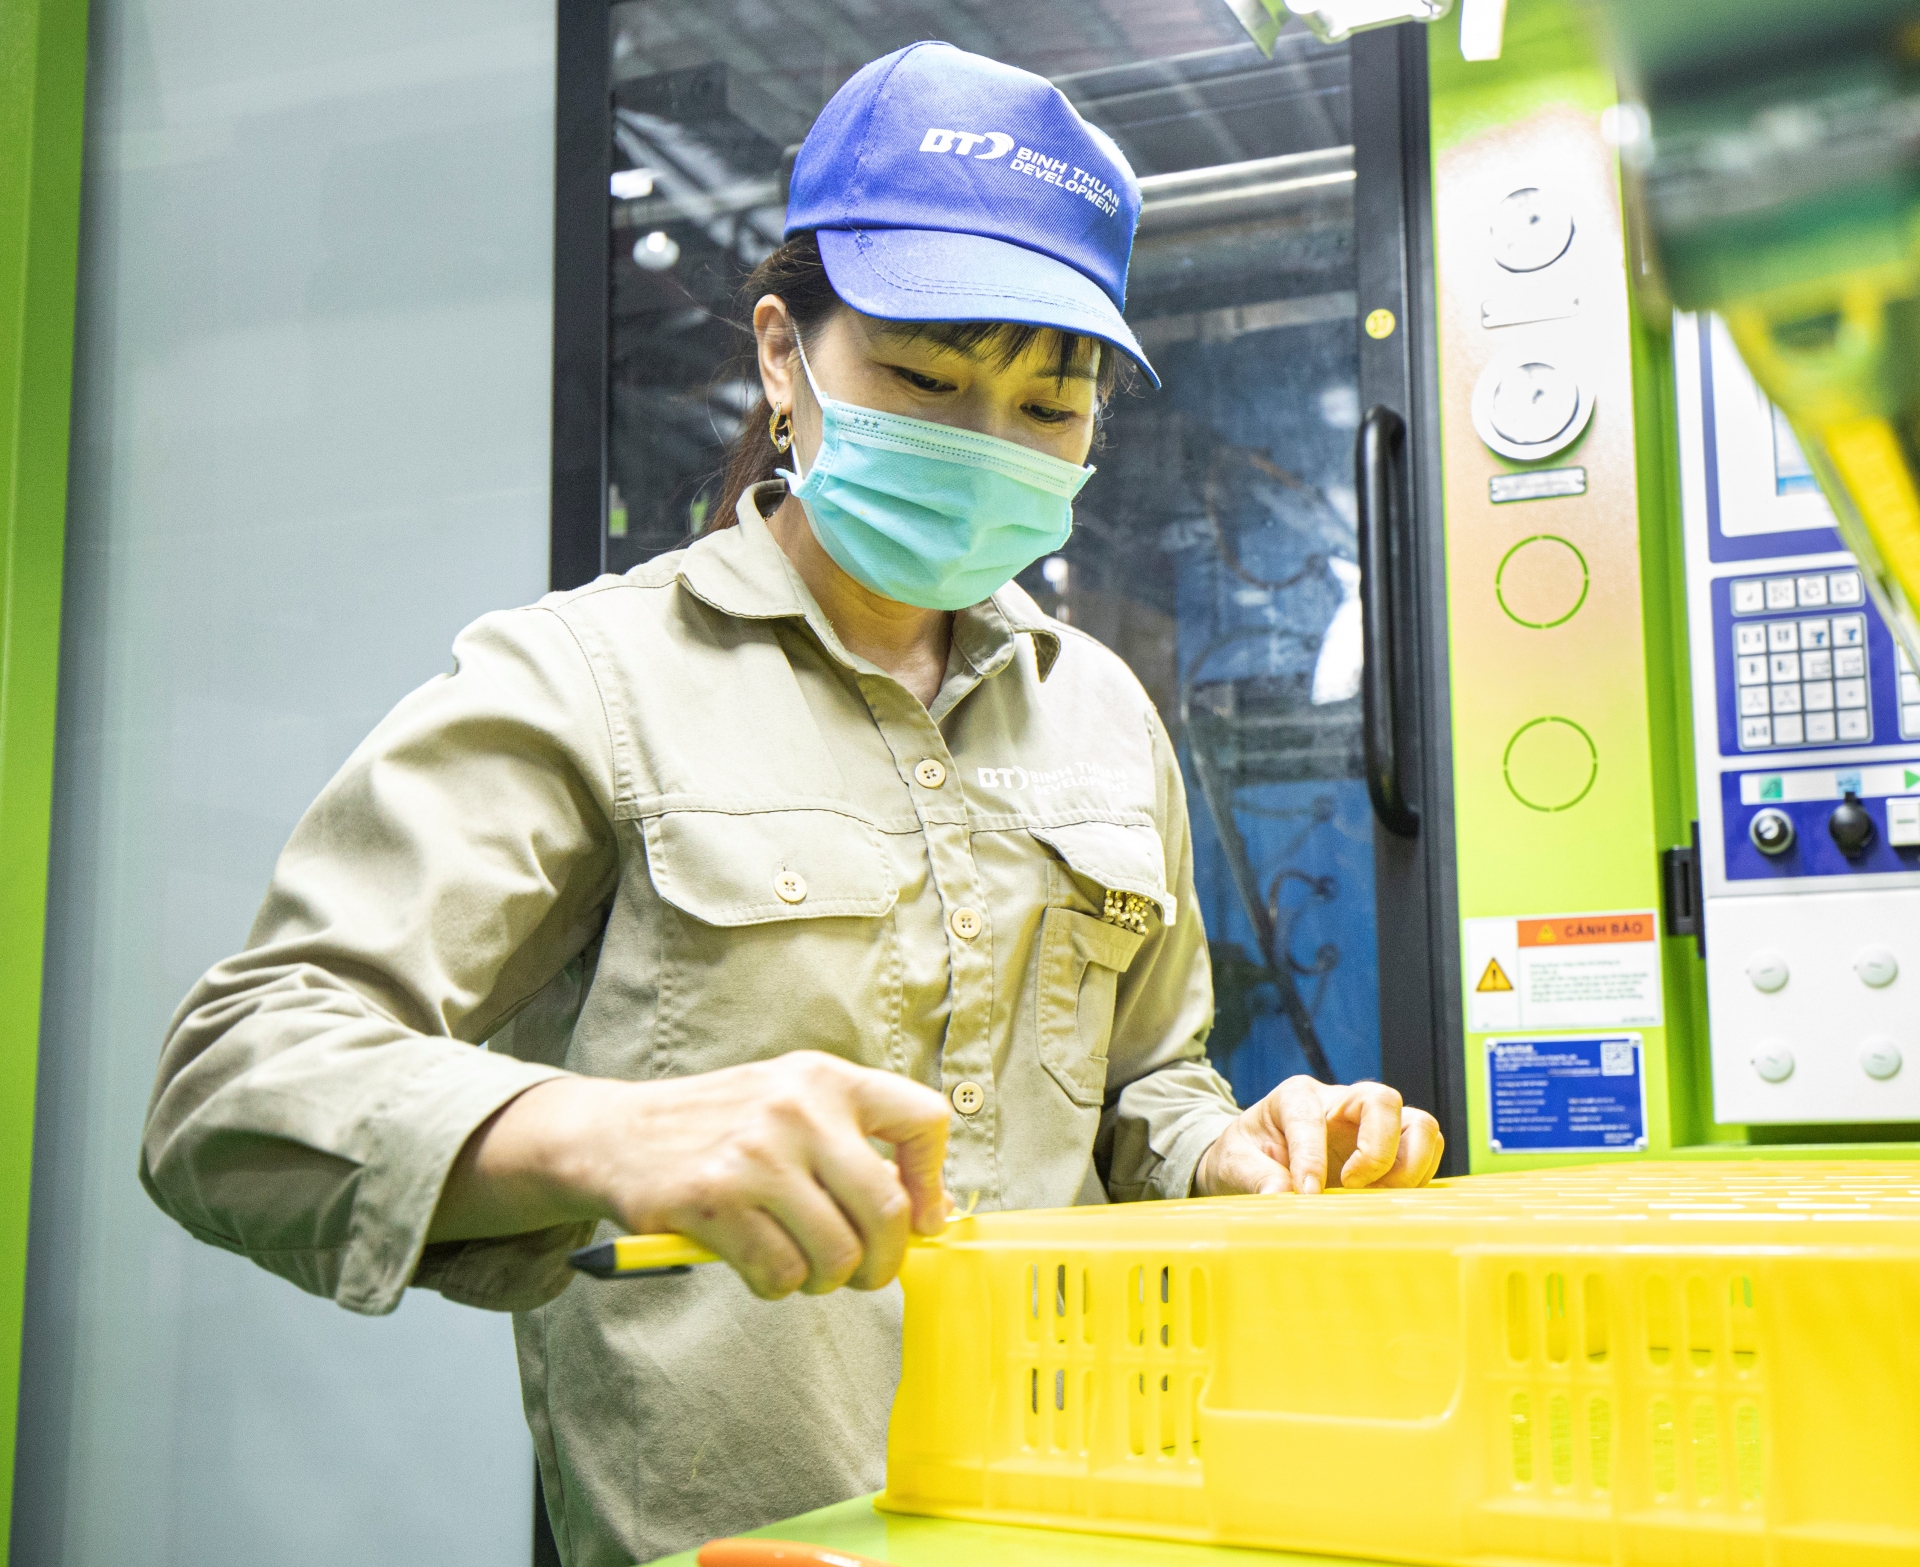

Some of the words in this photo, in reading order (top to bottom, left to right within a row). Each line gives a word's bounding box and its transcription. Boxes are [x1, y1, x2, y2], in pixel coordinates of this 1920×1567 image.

[1010, 158, 1118, 218] DEVELOPMENT
[1016, 146, 1068, 174] BINH
[1072, 166, 1120, 208] THUAN
[1030, 766, 1073, 785] BINH
[1075, 762, 1128, 782] THUAN
